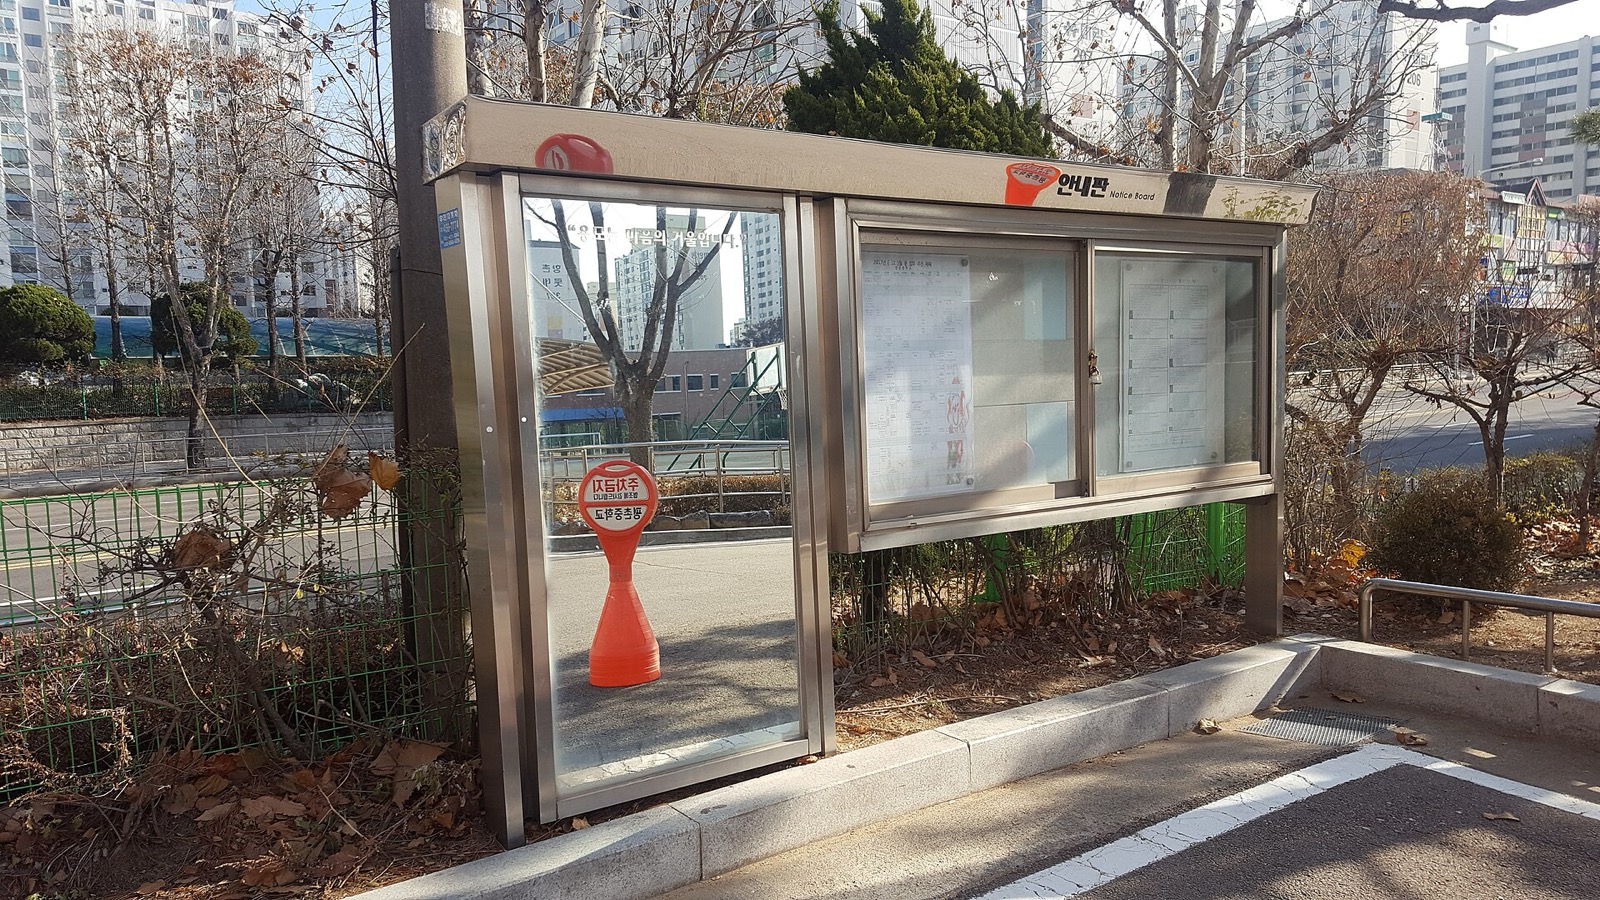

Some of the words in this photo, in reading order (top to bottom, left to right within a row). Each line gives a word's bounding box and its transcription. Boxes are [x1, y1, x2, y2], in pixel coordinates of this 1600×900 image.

[1056, 173, 1109, 198] 안내판
[1109, 190, 1133, 200] Notice
[1134, 192, 1155, 201] Board
